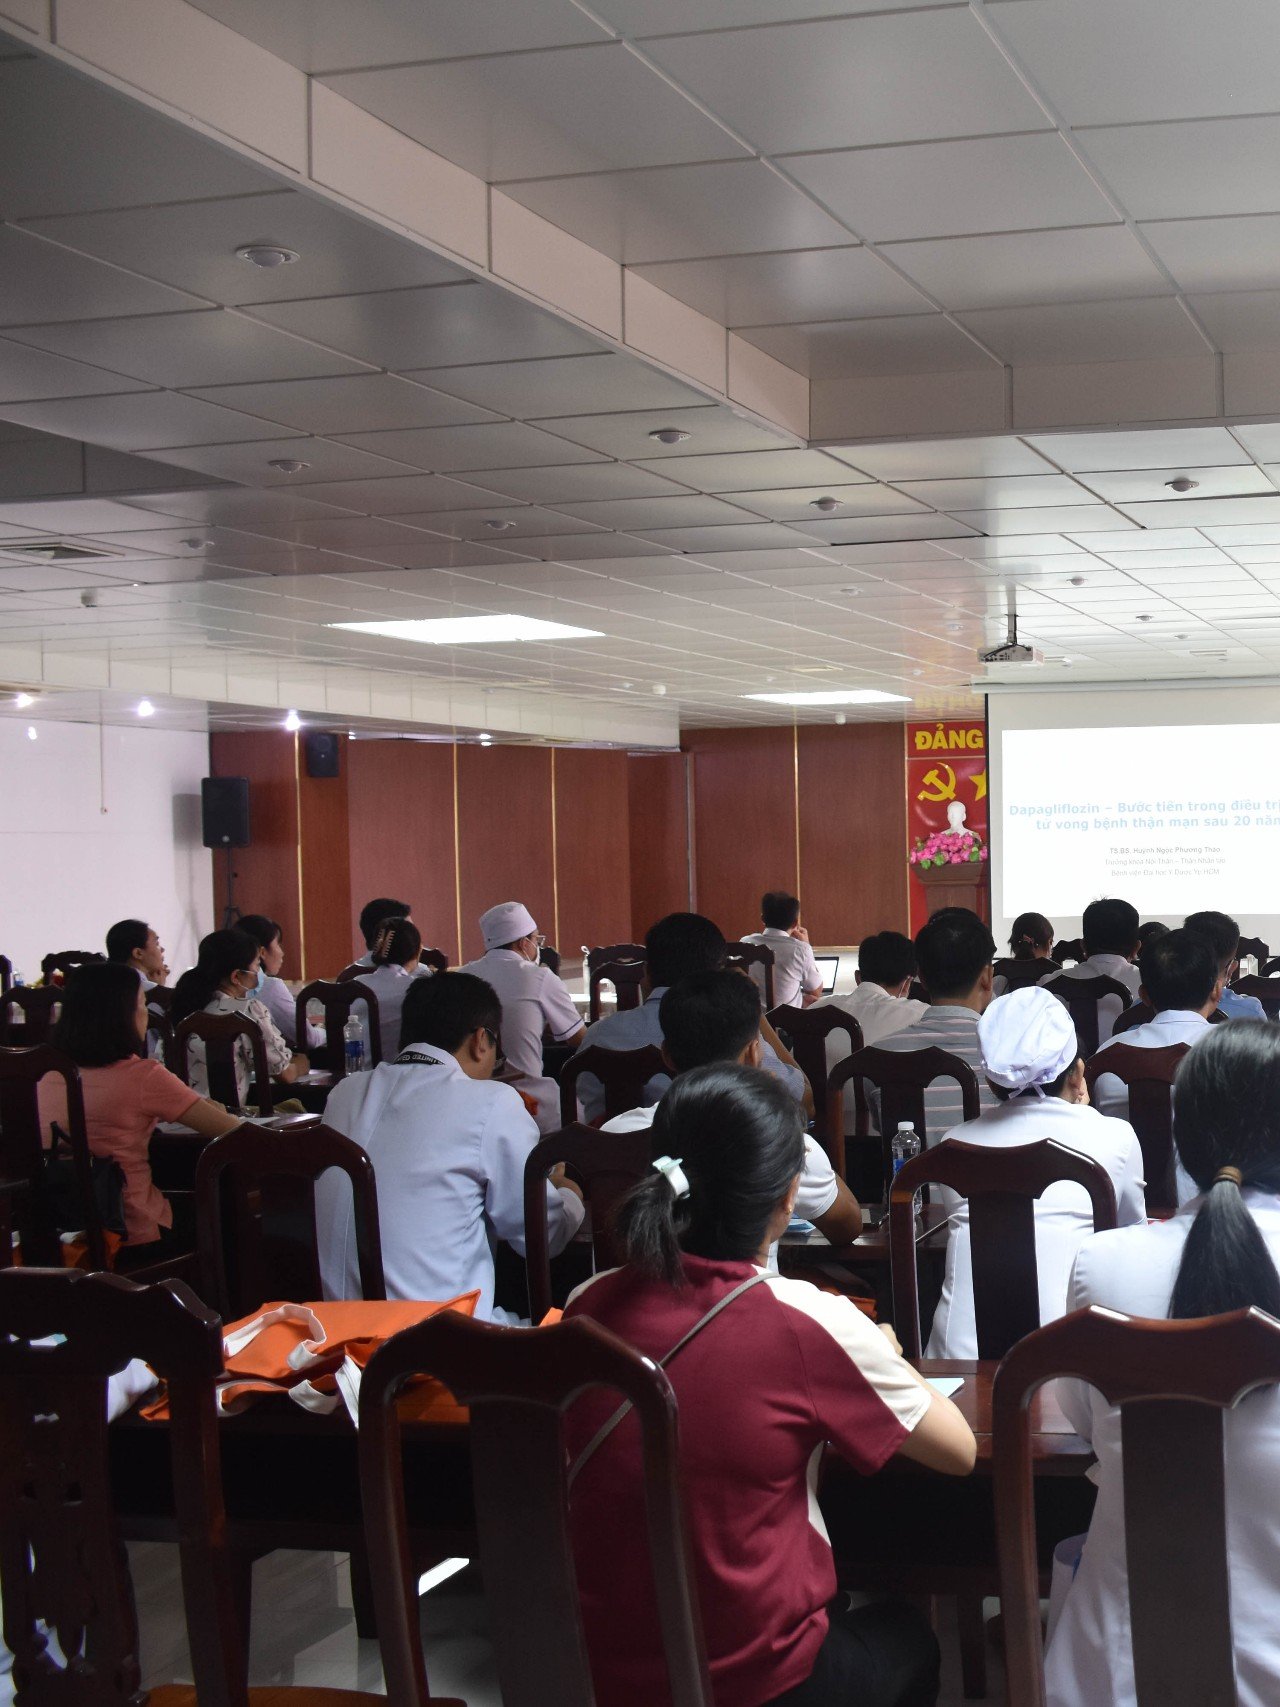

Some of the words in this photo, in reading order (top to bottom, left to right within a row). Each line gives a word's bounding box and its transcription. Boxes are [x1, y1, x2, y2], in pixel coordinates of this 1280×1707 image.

[915, 723, 984, 750] ĐẢNG
[1009, 802, 1100, 817] Dapagliflozin
[1118, 800, 1152, 813] Bước
[1188, 801, 1226, 813] trong
[1055, 820, 1089, 832] vong
[1094, 816, 1127, 830] bệnh
[1169, 817, 1199, 830] mạn
[1204, 817, 1228, 827] sau
[1234, 815, 1251, 826] 20
